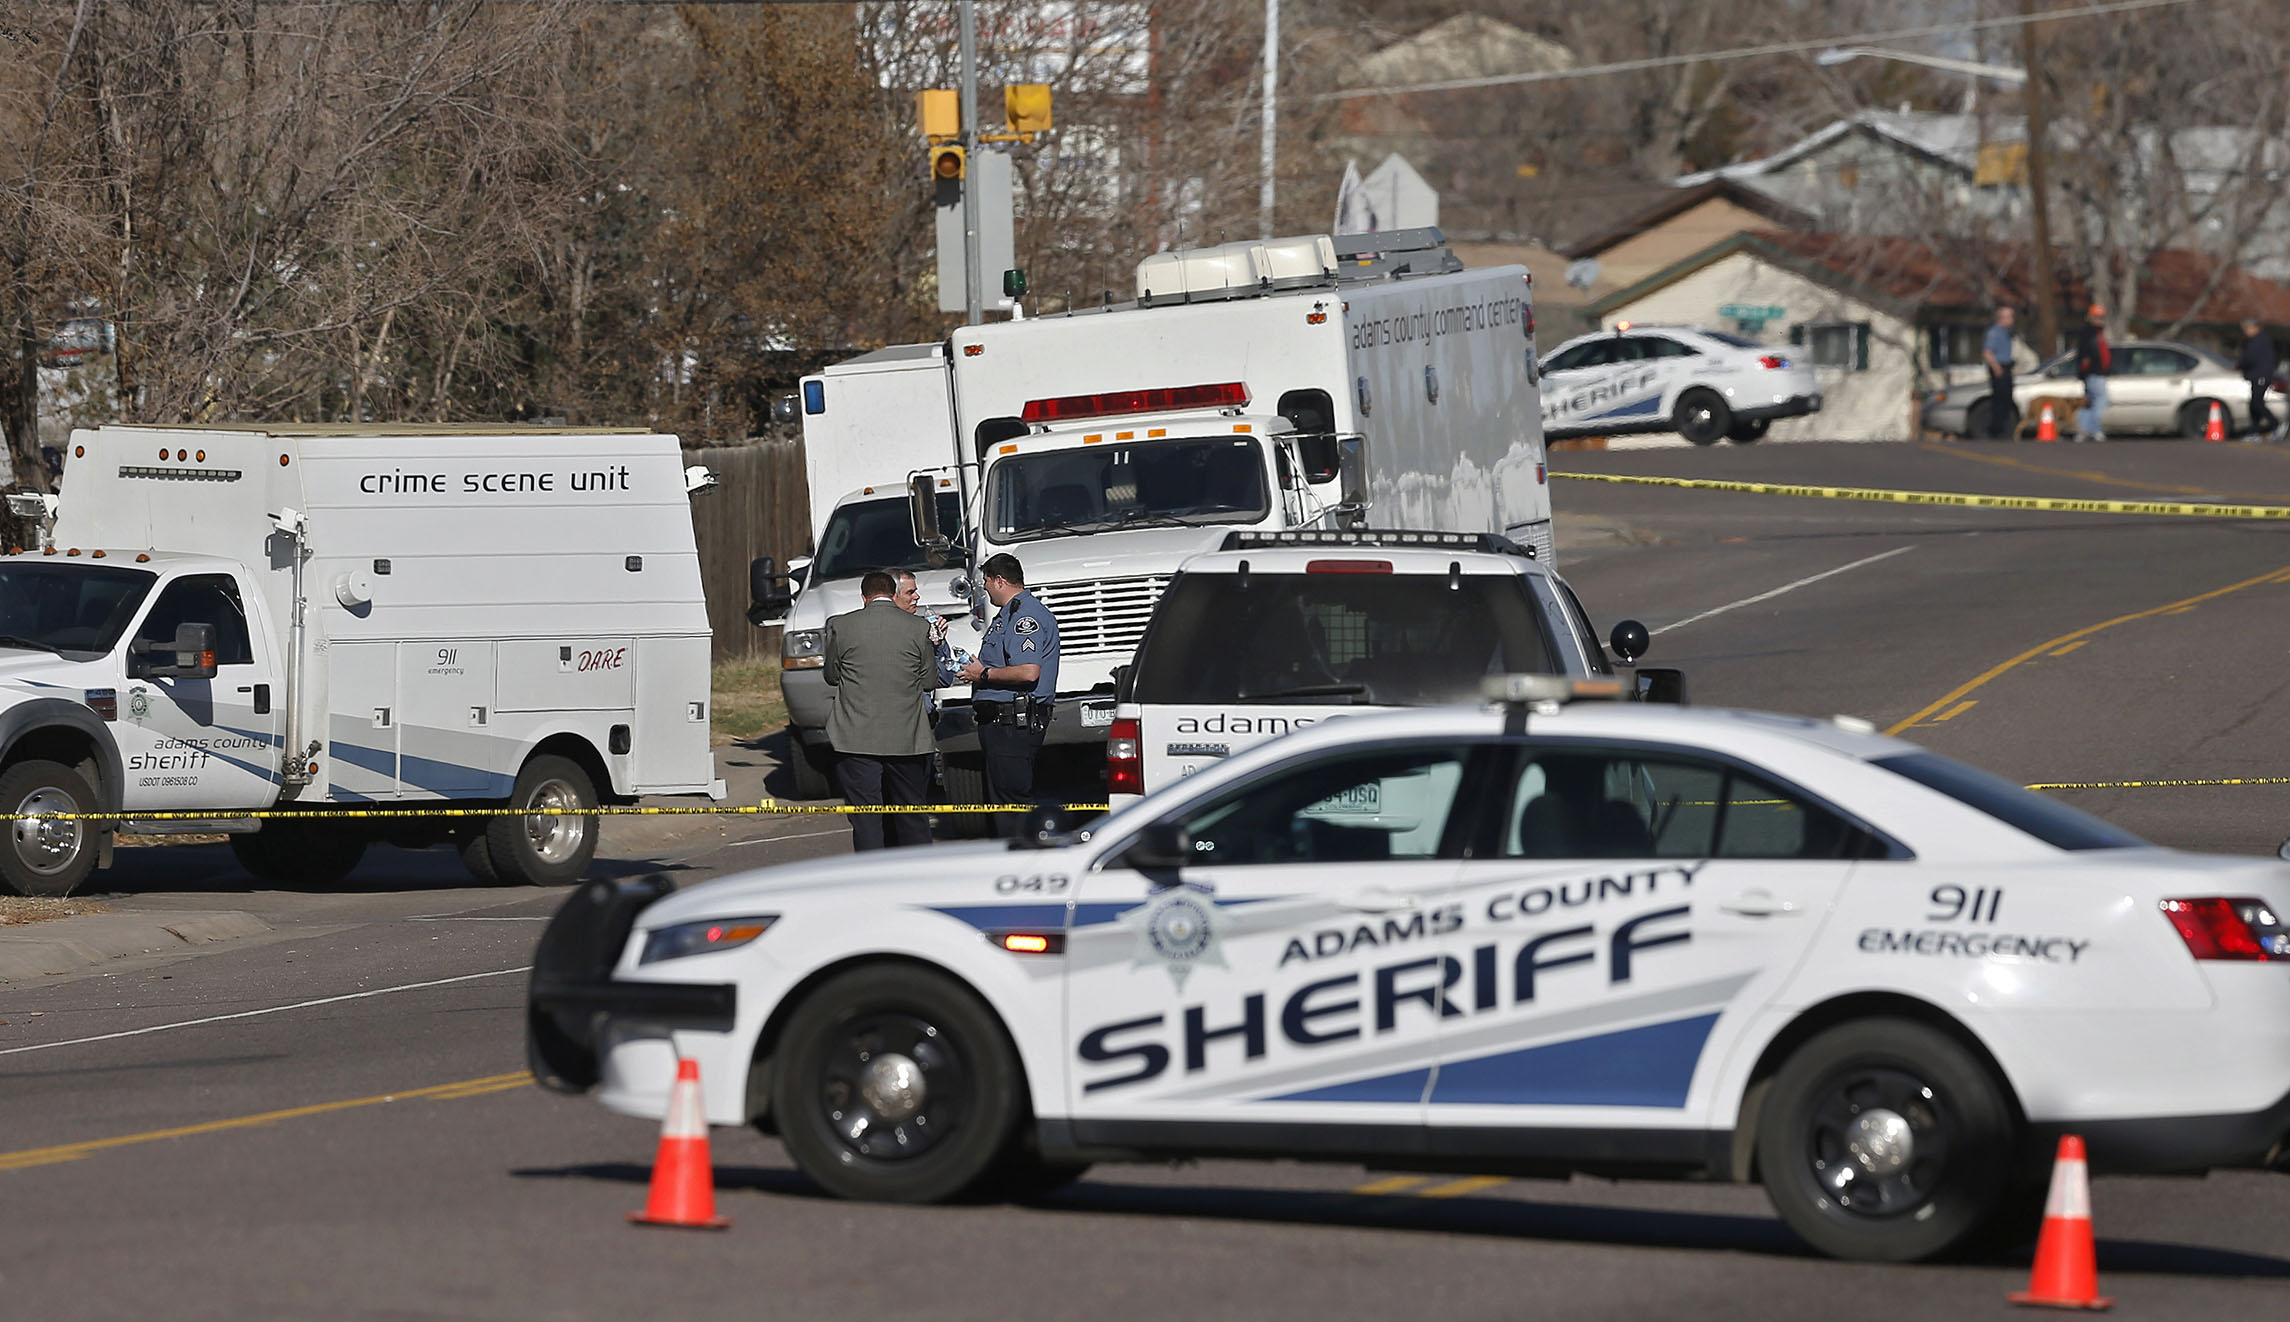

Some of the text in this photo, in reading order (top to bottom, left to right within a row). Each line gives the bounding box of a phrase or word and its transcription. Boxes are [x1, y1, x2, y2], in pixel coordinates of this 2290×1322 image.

[1352, 291, 1521, 350] adams county command center
[359, 465, 630, 494] crime scene unit
[427, 666, 465, 676] emergency
[436, 648, 458, 666] 911
[153, 736, 269, 751] adams county
[129, 752, 210, 769] sheriff
[995, 873, 1069, 894] 049
[1278, 904, 1464, 968] ADAMS
[1487, 864, 1703, 923] COUNTY
[1925, 883, 2005, 923] 911
[1857, 928, 2091, 963] EMERGENCY
[1078, 905, 1693, 1095] SHERIFF
